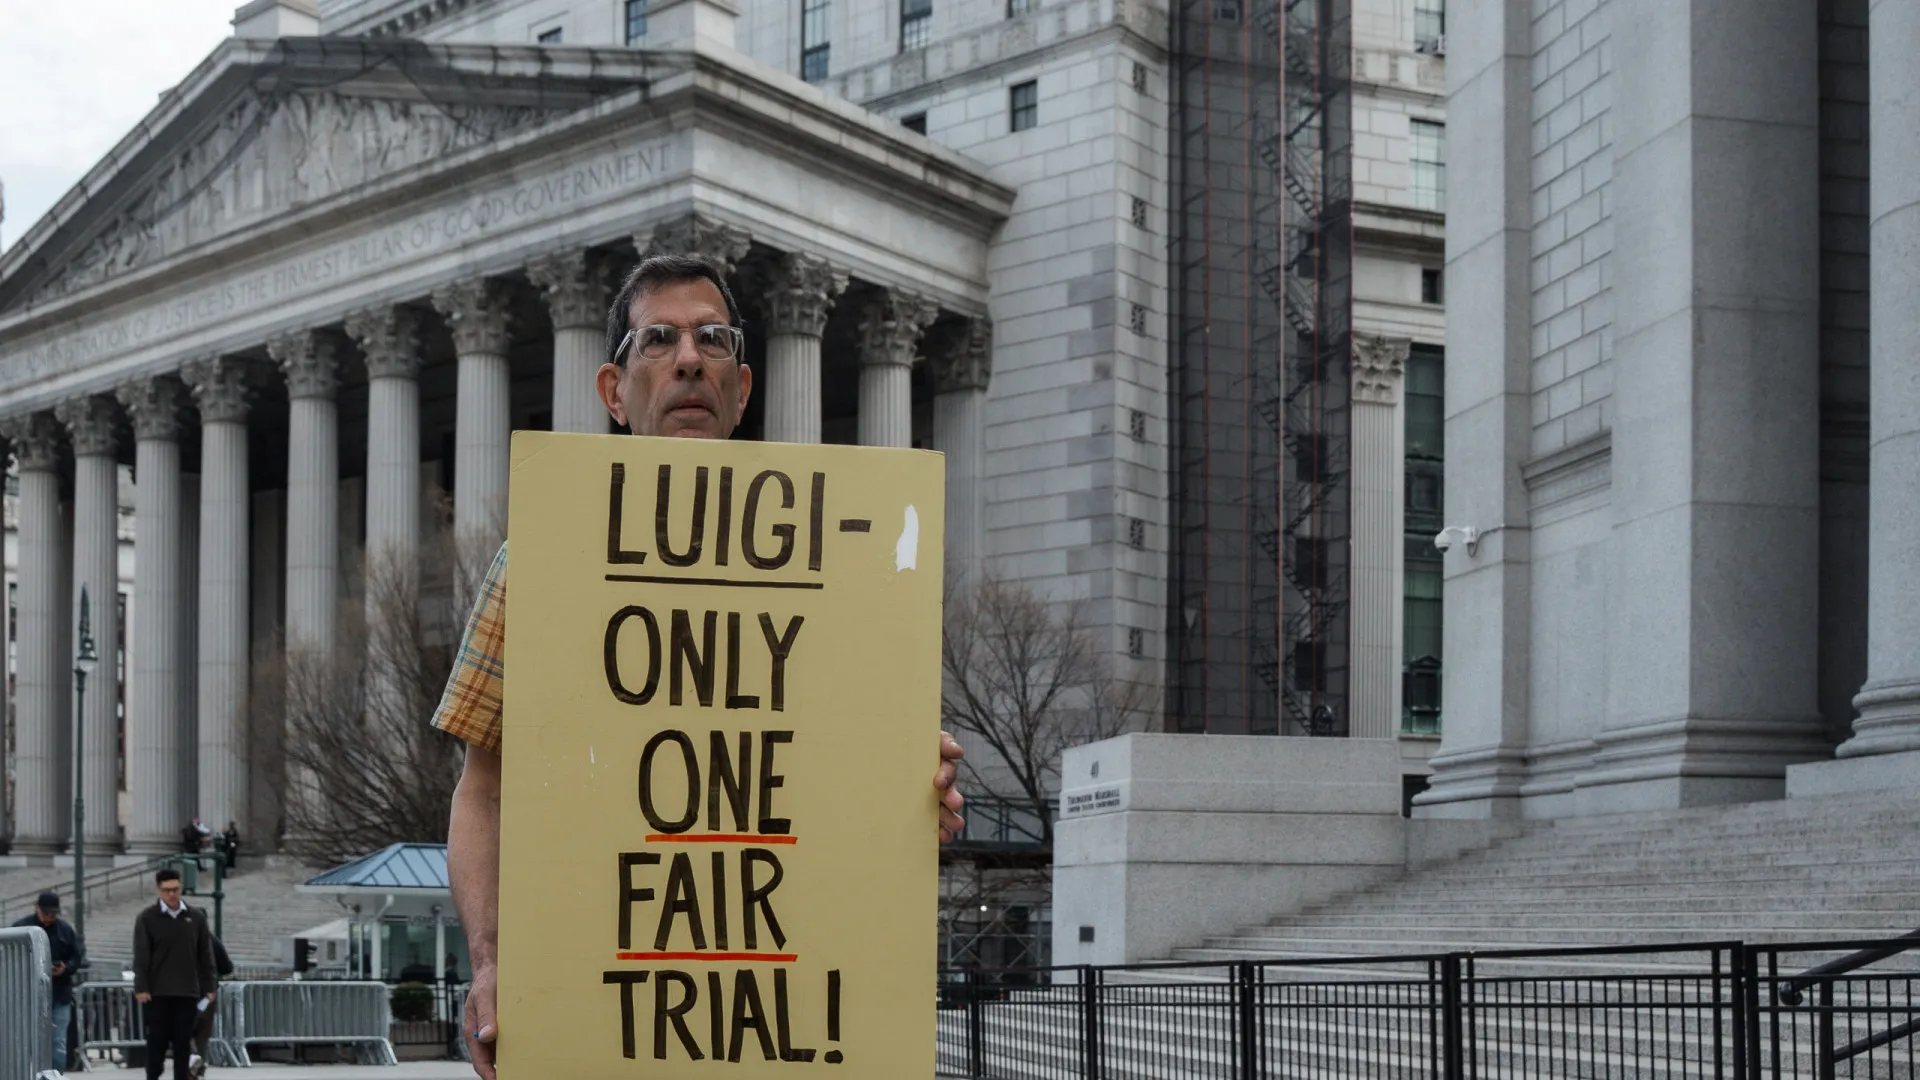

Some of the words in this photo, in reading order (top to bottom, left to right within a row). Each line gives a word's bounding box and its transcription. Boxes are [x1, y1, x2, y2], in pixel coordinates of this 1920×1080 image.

[156, 292, 215, 332] JUSTICE
[221, 284, 235, 310] IS
[240, 274, 267, 305] THE
[273, 249, 341, 294] FIRMEST
[348, 229, 405, 270] PILLAR
[410, 217, 437, 249] OF
[443, 196, 505, 239] GOOD
[512, 142, 671, 216] GOVERNMENT
[607, 463, 871, 571] LUIGI-
[604, 605, 804, 711] ONLY
[638, 729, 794, 834] ONE
[618, 848, 787, 951] FAIR
[603, 968, 844, 1063] TRIAL!
